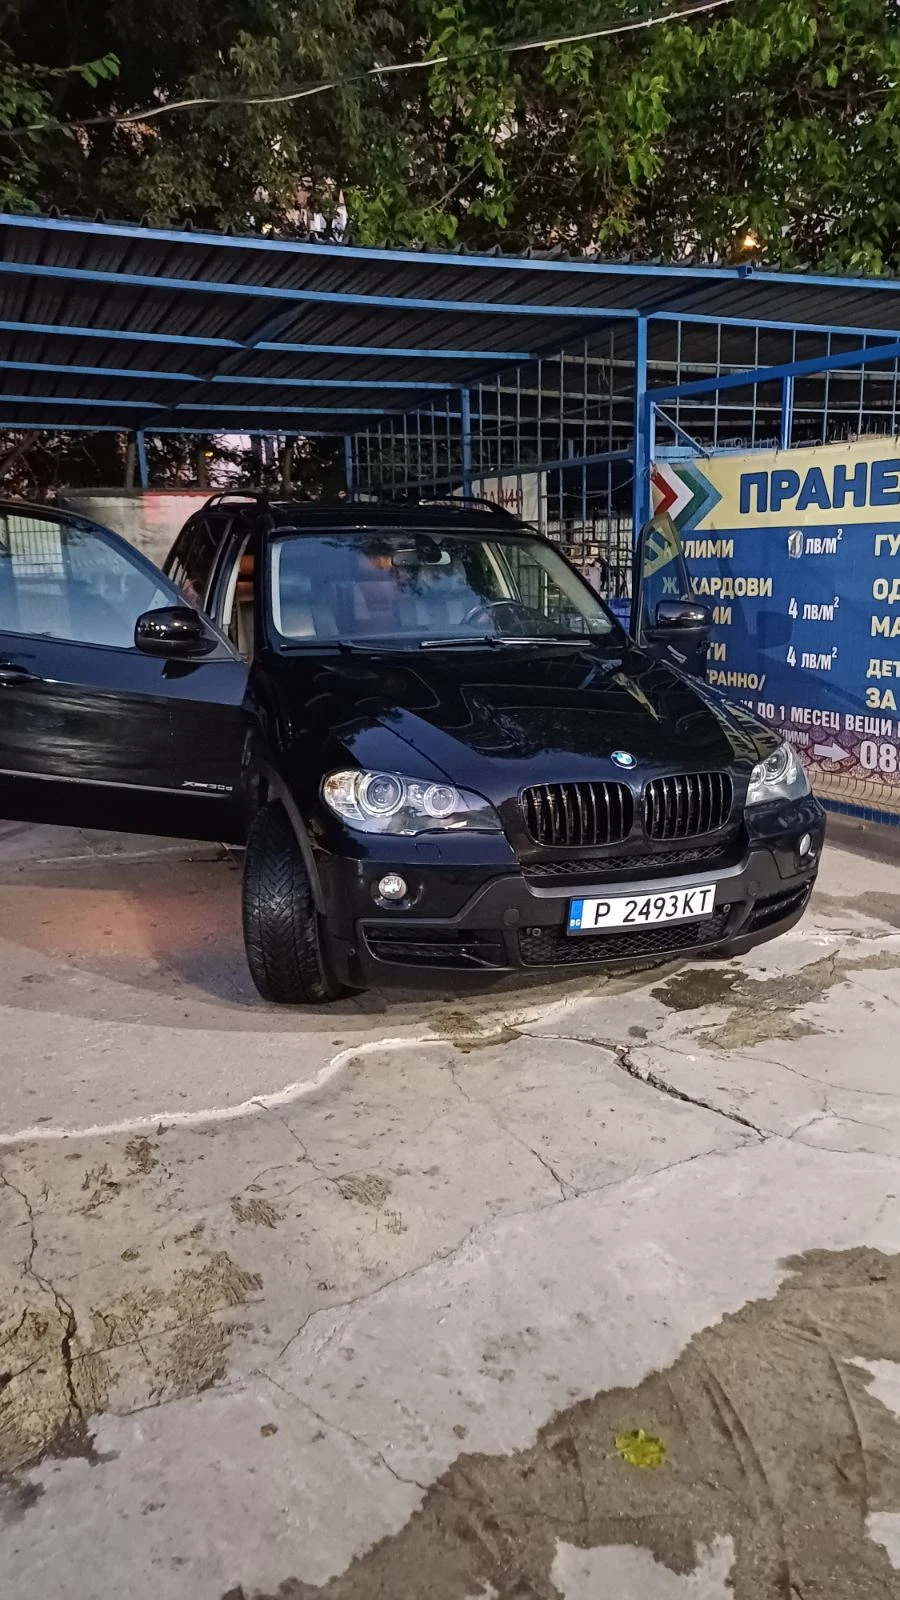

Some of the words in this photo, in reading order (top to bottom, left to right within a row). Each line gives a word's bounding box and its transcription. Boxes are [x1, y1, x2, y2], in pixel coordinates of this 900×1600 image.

[739, 458, 900, 514] ПРАНЕ
[680, 539, 734, 558] ЛИМИ
[661, 576, 773, 599] ЖКАРДОВИ
[788, 597, 798, 619] 4
[786, 646, 797, 668] 4
[707, 669, 766, 691] РАННО/
[865, 687, 897, 710] ЗА
[757, 701, 775, 719] ДО
[780, 705, 786, 721] 1
[791, 706, 840, 731] МЕСЕЦ
[845, 713, 893, 737] ВЕЩИ
[860, 740, 900, 774] 08
